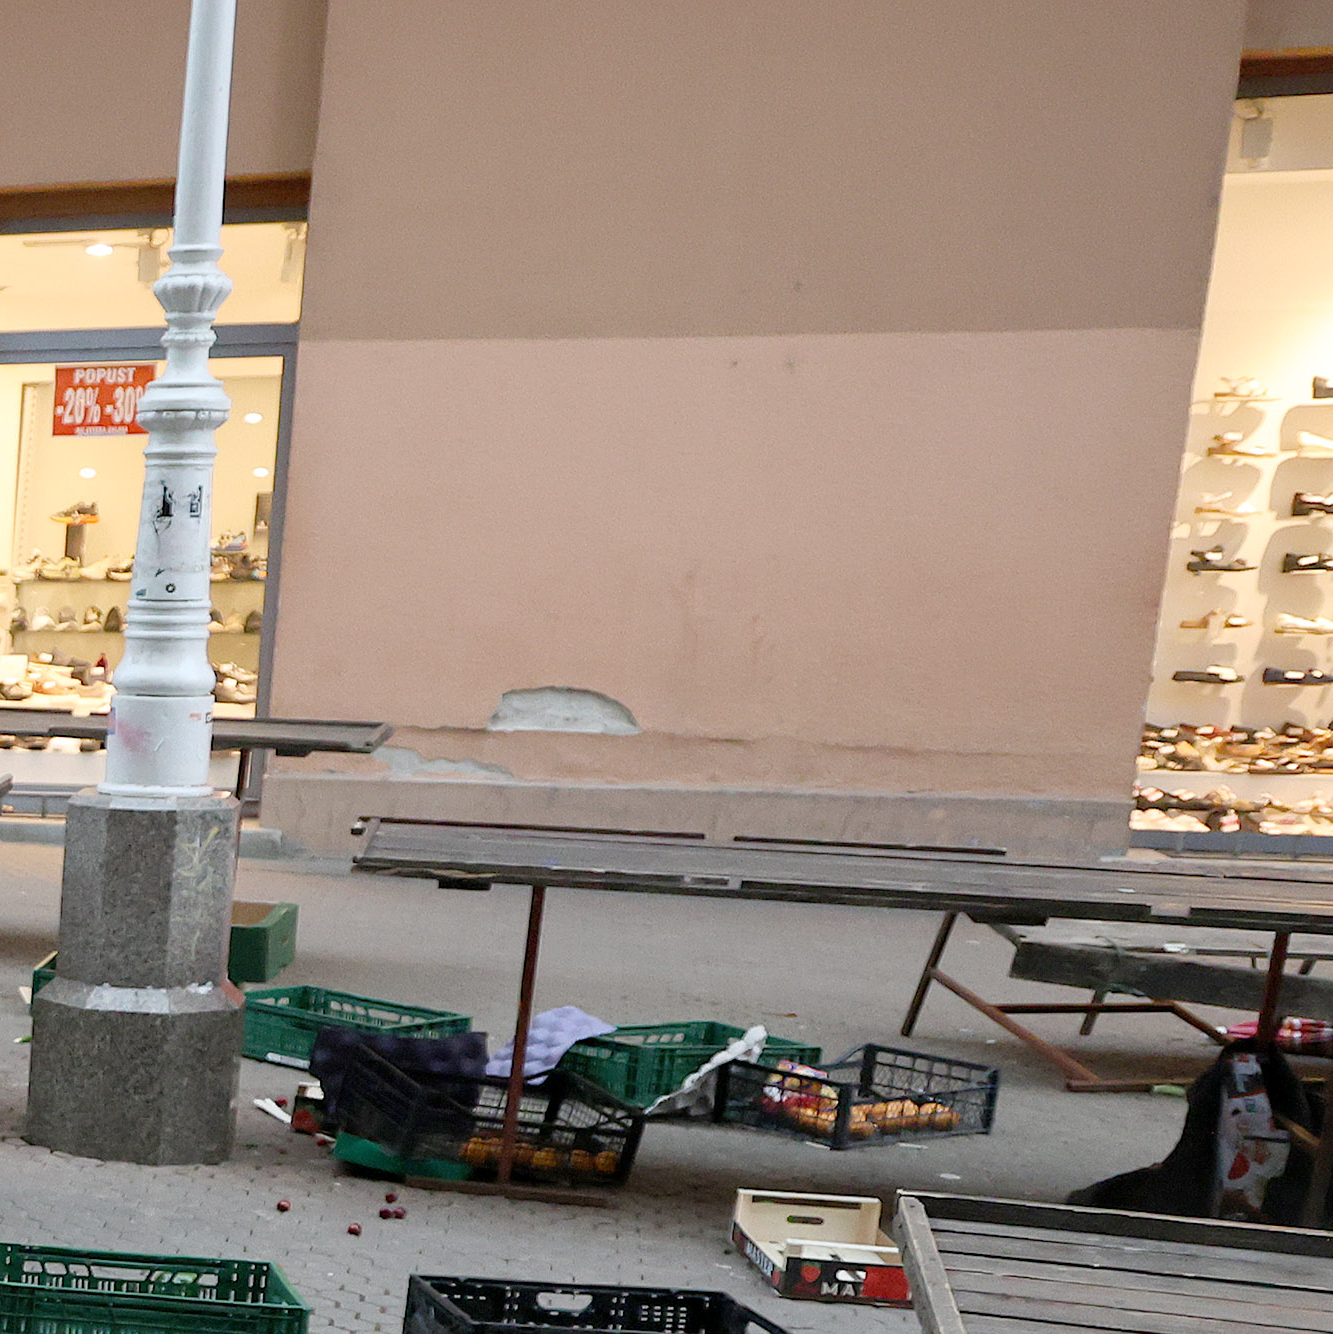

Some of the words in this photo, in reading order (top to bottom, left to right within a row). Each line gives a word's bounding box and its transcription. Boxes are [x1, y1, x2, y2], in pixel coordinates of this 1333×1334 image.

[73, 367, 137, 384] POPUST
[56, 386, 101, 424] -20%
[745, 1240, 774, 1278] MASTER
